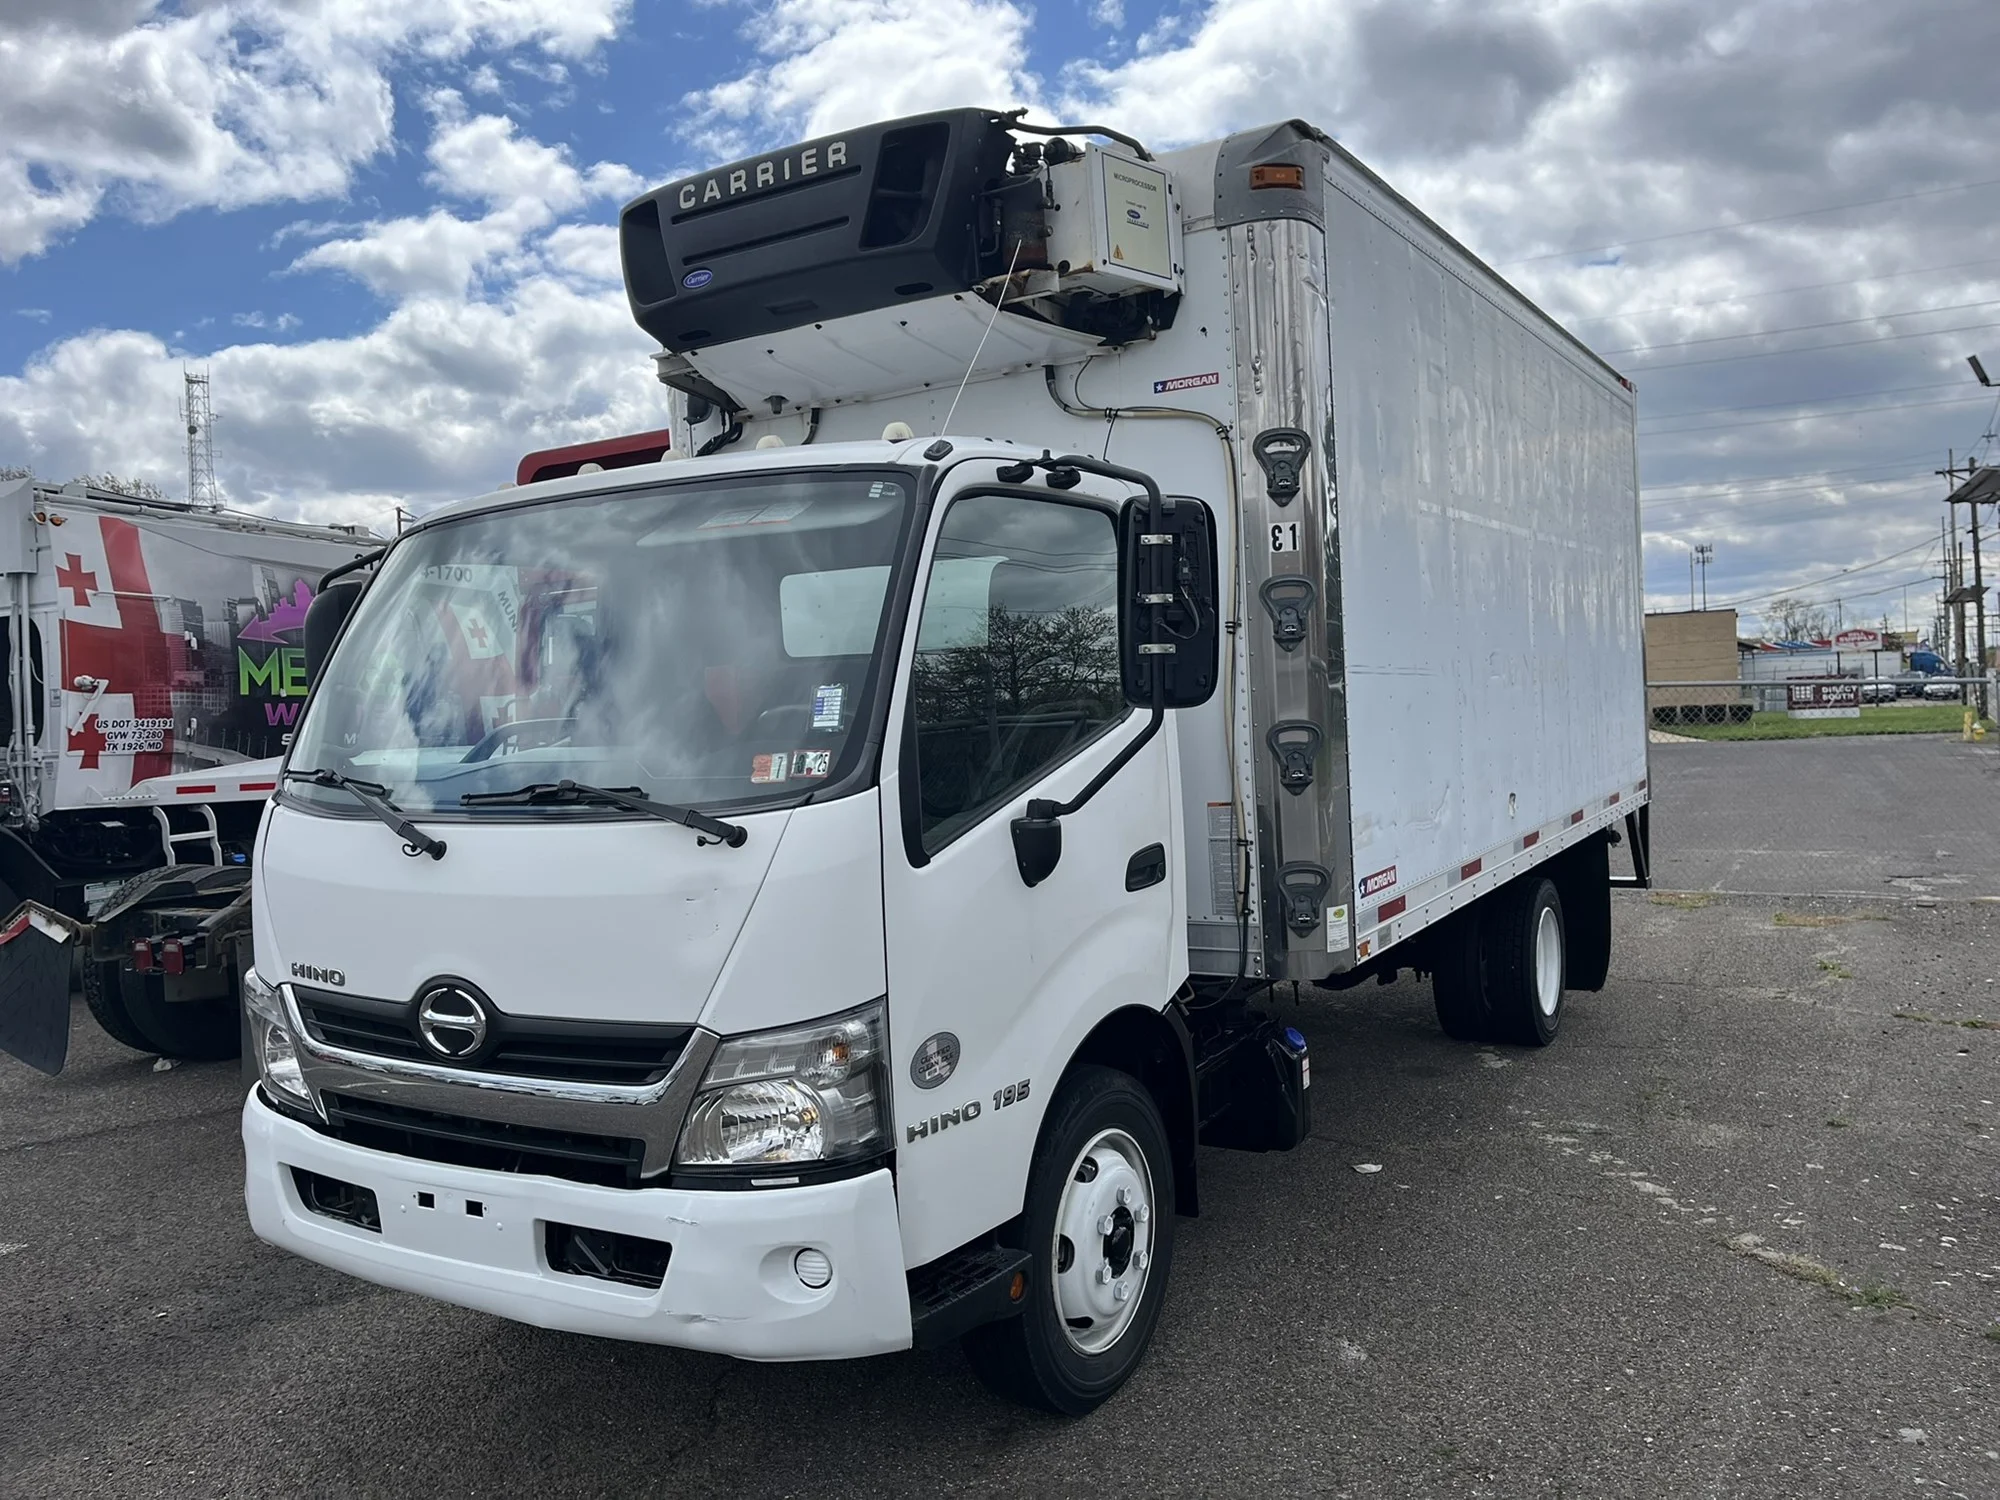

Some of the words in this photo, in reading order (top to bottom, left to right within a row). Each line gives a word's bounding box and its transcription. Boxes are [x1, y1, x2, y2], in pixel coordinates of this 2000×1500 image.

[679, 141, 847, 210] CARRIER
[1113, 172, 1157, 192] MICROPROCESSOR
[1165, 374, 1218, 391] MORGAN
[96, 720, 109, 729] US
[111, 720, 131, 729] DOT
[133, 720, 173, 728] 3419191
[107, 731, 129, 740] GVW
[131, 731, 163, 740] 73,280
[106, 742, 119, 751] TK
[121, 742, 145, 751] 1926
[146, 742, 162, 750] MD
[817, 753, 829, 773] 25
[1366, 869, 1396, 893] MORGAN
[291, 962, 345, 986] HINO
[906, 1100, 982, 1144] HINO
[992, 1078, 1031, 1111] 195
